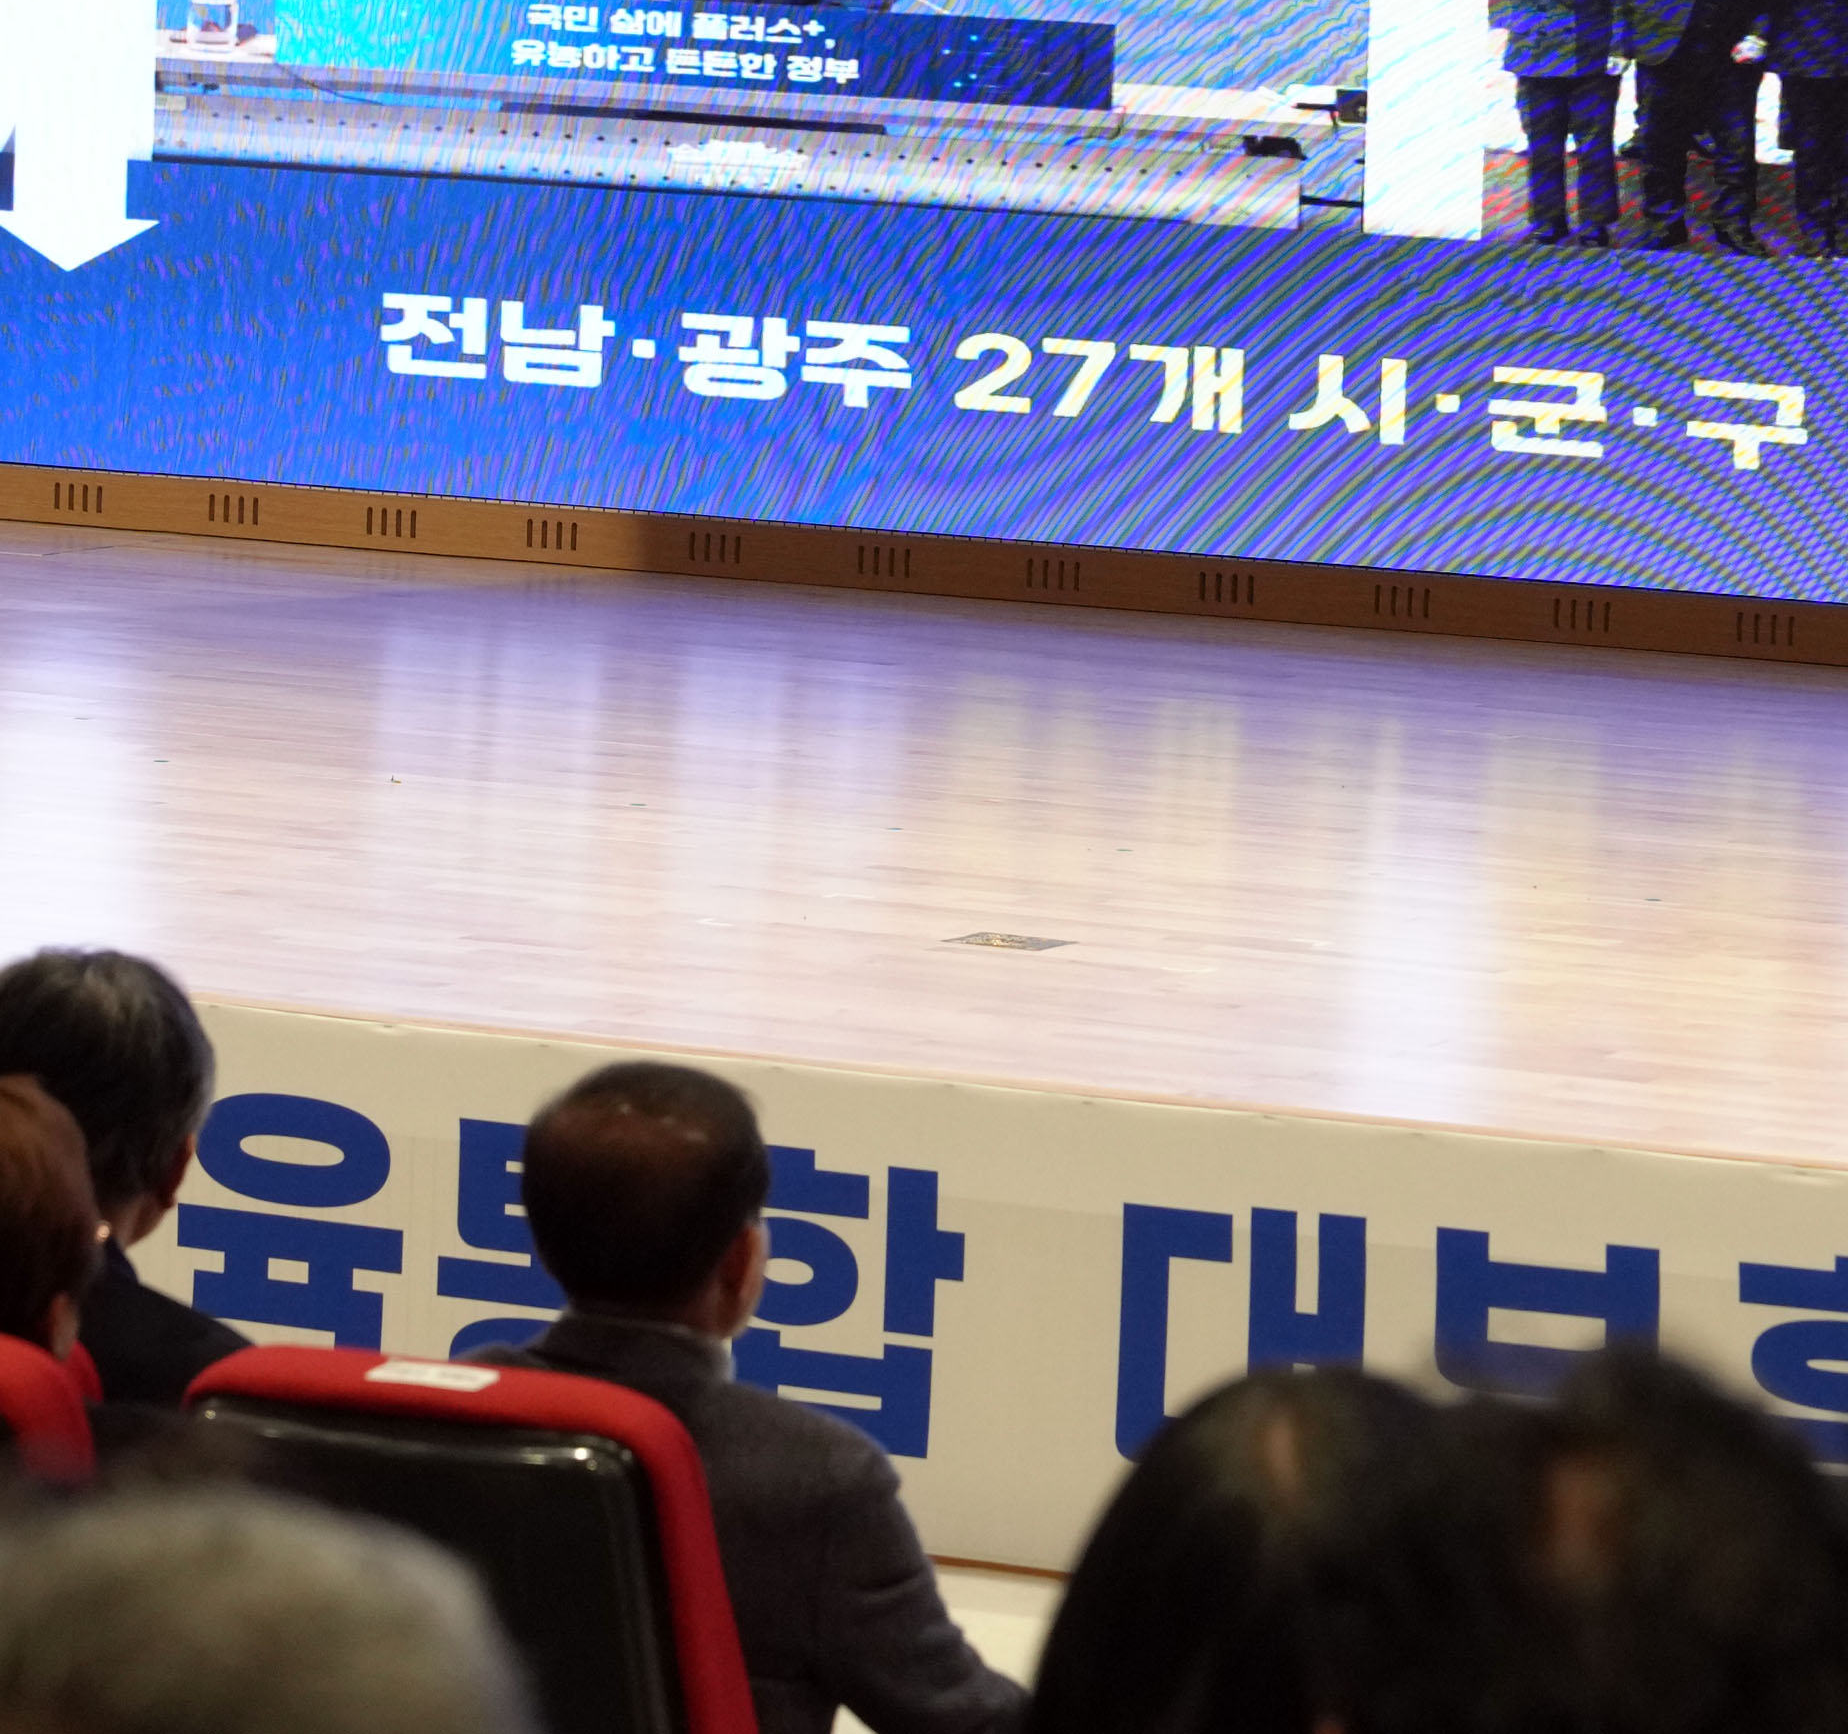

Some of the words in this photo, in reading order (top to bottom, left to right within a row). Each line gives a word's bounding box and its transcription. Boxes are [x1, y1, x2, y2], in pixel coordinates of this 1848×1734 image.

[528, 3, 599, 32] 국민
[510, 39, 654, 72] 유능하고
[666, 47, 776, 80] 든든한
[786, 55, 860, 84] 정부
[377, 290, 914, 408] 전남·광주
[954, 330, 1247, 434] 27개
